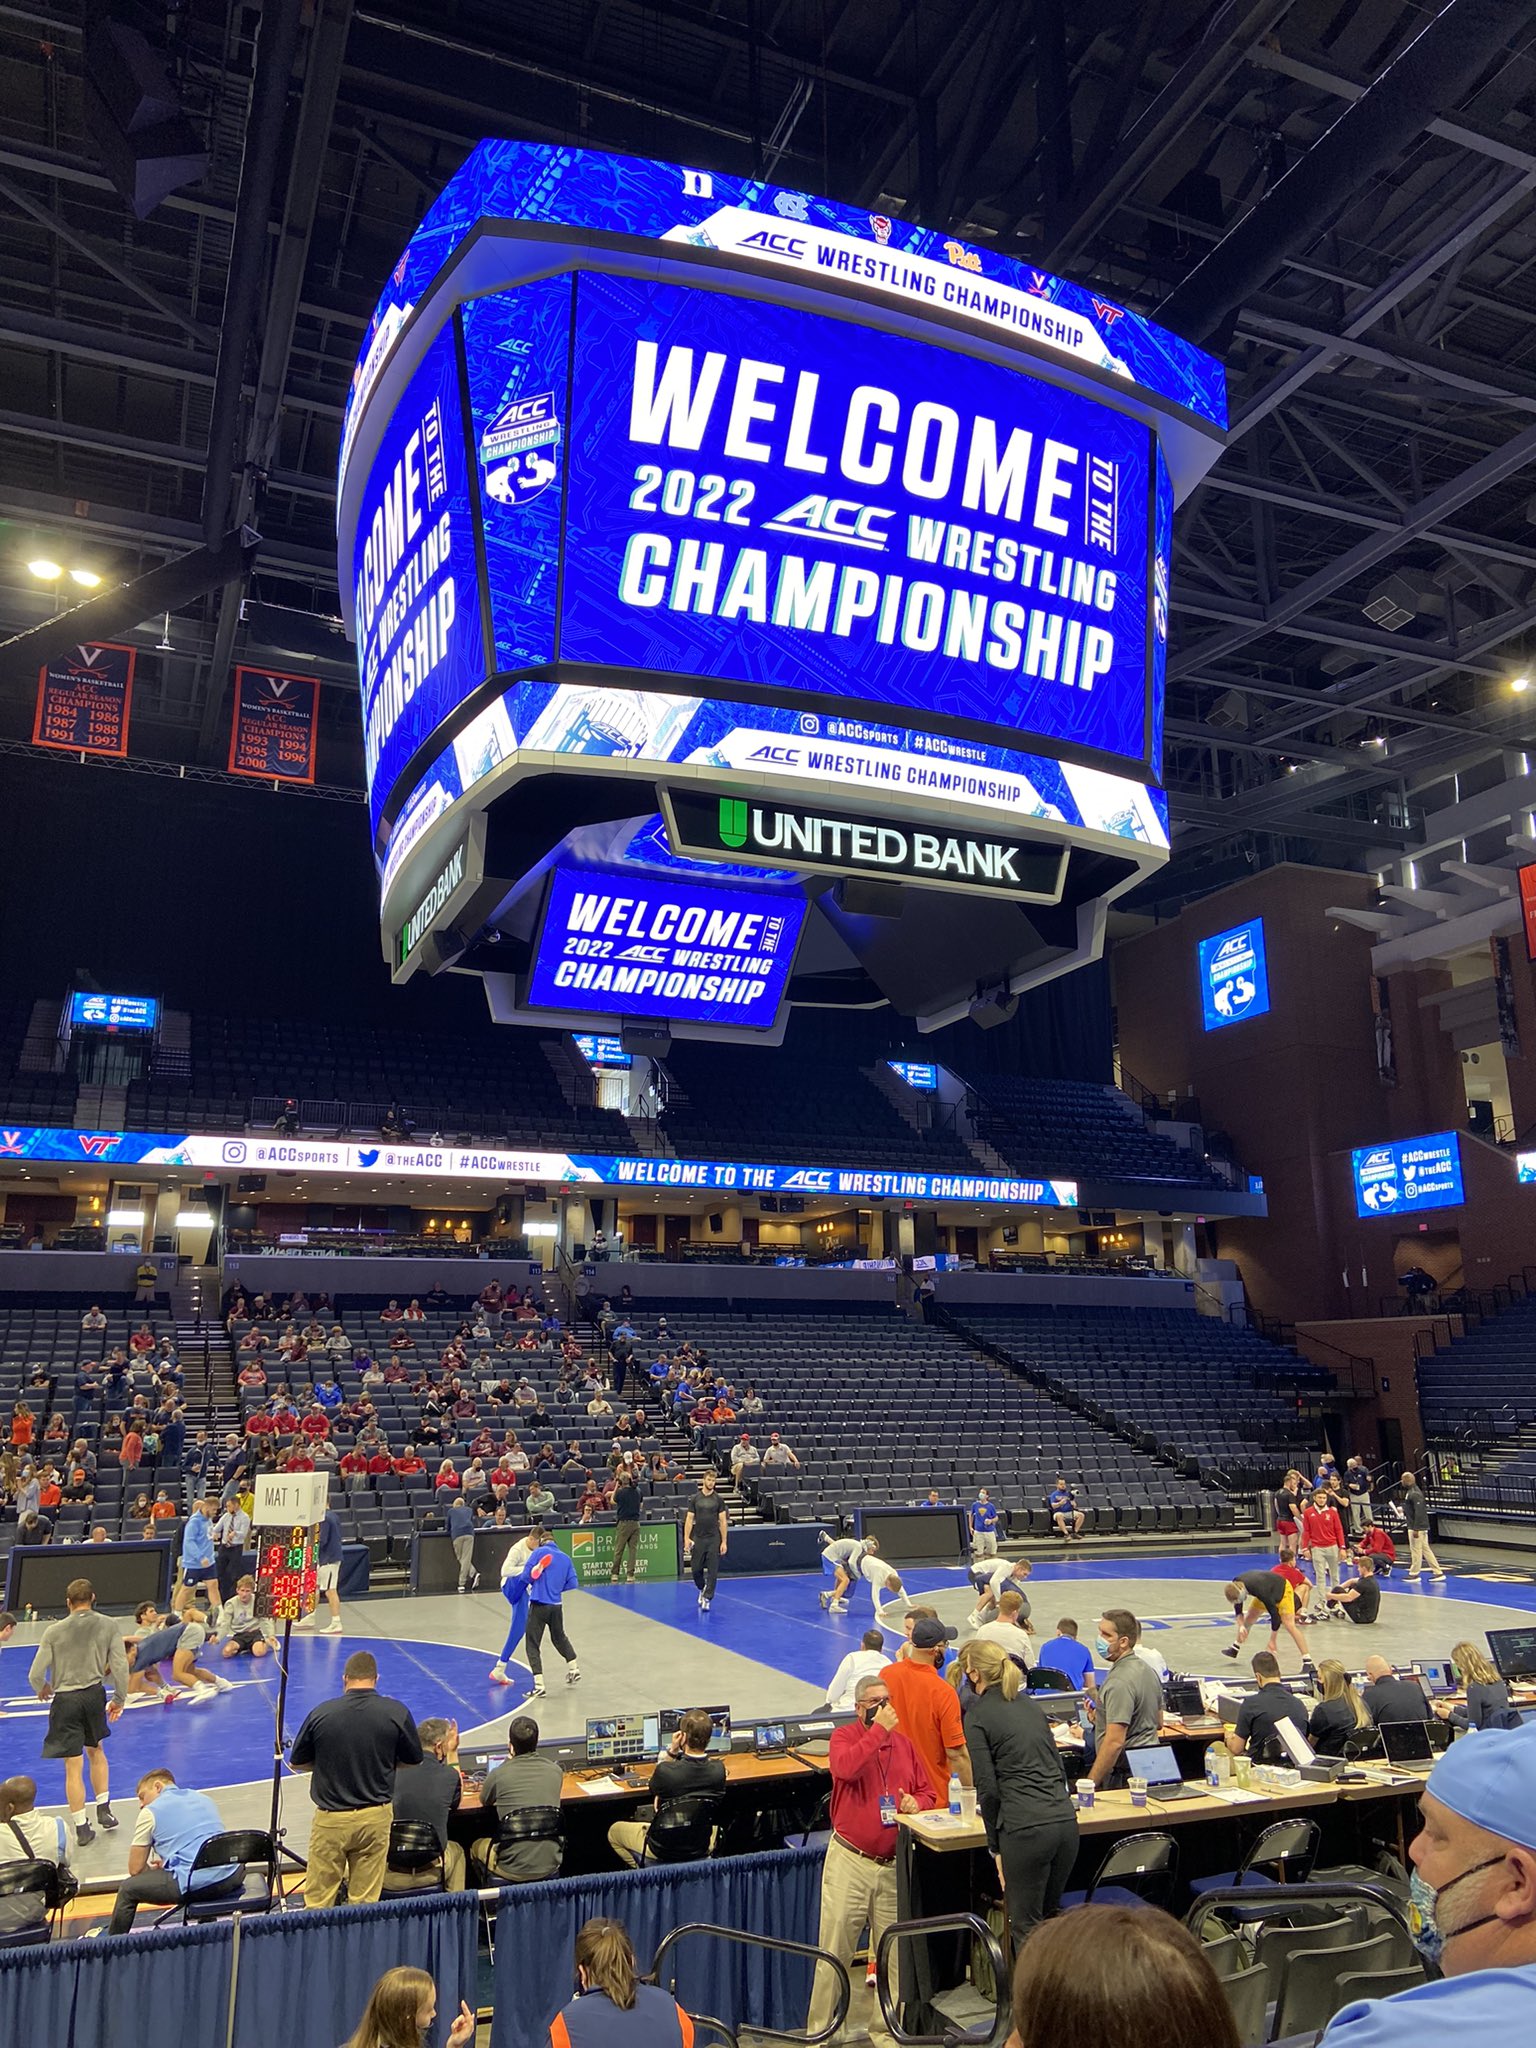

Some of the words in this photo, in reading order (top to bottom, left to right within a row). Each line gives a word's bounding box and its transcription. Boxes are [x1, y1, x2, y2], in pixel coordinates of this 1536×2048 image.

[736, 231, 808, 259] ACC
[817, 244, 935, 296] WRESTLING
[943, 282, 1084, 347] CHAMPIONSHIP
[1092, 298, 1124, 325] VT
[496, 338, 533, 355] ACC
[424, 401, 438, 439] TO
[493, 397, 549, 431] ACC
[490, 421, 550, 443] WRESTLING
[629, 340, 1079, 537] WELCOME
[486, 429, 555, 458] CHAMPIONSHIP
[429, 449, 445, 502] THE
[1092, 456, 1113, 493] TO
[1091, 498, 1112, 552] THE
[629, 465, 755, 526] 2022
[761, 495, 896, 549] ACC
[907, 515, 1117, 612] WRESTLING
[379, 511, 450, 660] WRESTLING
[619, 532, 1114, 691] CHAMPIONSHIP
[49, 672, 81, 682] WOMEN'S
[82, 678, 124, 689] BASKETBALL
[74, 684, 98, 694] ACC
[48, 687, 88, 699] REGULAR
[89, 694, 122, 704] SEASON
[50, 695, 118, 712] CHAMPIONS
[47, 703, 78, 718] 1984
[90, 710, 119, 724] 1986
[241, 702, 271, 712] WOMEN'S
[272, 708, 311, 719] BASKETBALL
[265, 714, 286, 723] ACC
[46, 715, 77, 729] 1987
[88, 722, 119, 735] 1988
[241, 717, 277, 729] REGULAR
[279, 723, 308, 733] SEASON
[243, 725, 305, 740] CHAMPIONS
[45, 727, 74, 741] 1991
[87, 734, 117, 747] 1992
[241, 733, 268, 746] 1993
[279, 739, 307, 753] 1994
[238, 756, 267, 769] 2000
[240, 745, 267, 758] 1995
[278, 751, 306, 764] 1996
[745, 745, 802, 766] ACC
[807, 751, 901, 781] WRESTLING
[907, 767, 1021, 802] CHAMPIONSHIP
[752, 809, 908, 864] UNITED
[912, 832, 1021, 882] BANK
[408, 887, 437, 950] UNITED
[436, 844, 464, 910] BANK
[566, 892, 763, 950] WELCOME
[769, 917, 782, 931] TO
[762, 932, 778, 953] THE
[1216, 934, 1248, 961] ACC
[563, 938, 614, 959] 2022
[613, 945, 670, 964] ACC
[672, 949, 774, 975] WRESTLING
[553, 961, 766, 1005] CHAMPIONSHIP
[79, 1136, 121, 1155] VT
[1364, 1151, 1391, 1167] ACC
[618, 1161, 707, 1184] WELCOME
[714, 1166, 736, 1186] TO
[743, 1168, 775, 1187] THE
[780, 1171, 834, 1189] ACC
[839, 1173, 926, 1196] WRESTLING
[931, 1177, 1044, 1201] CHAMPIONSHIP
[265, 1488, 288, 1506] MAT
[295, 1488, 300, 1506] 1
[597, 1533, 658, 1545] PRUM
[582, 1561, 603, 1570] START
[584, 1569, 591, 1577] IN
